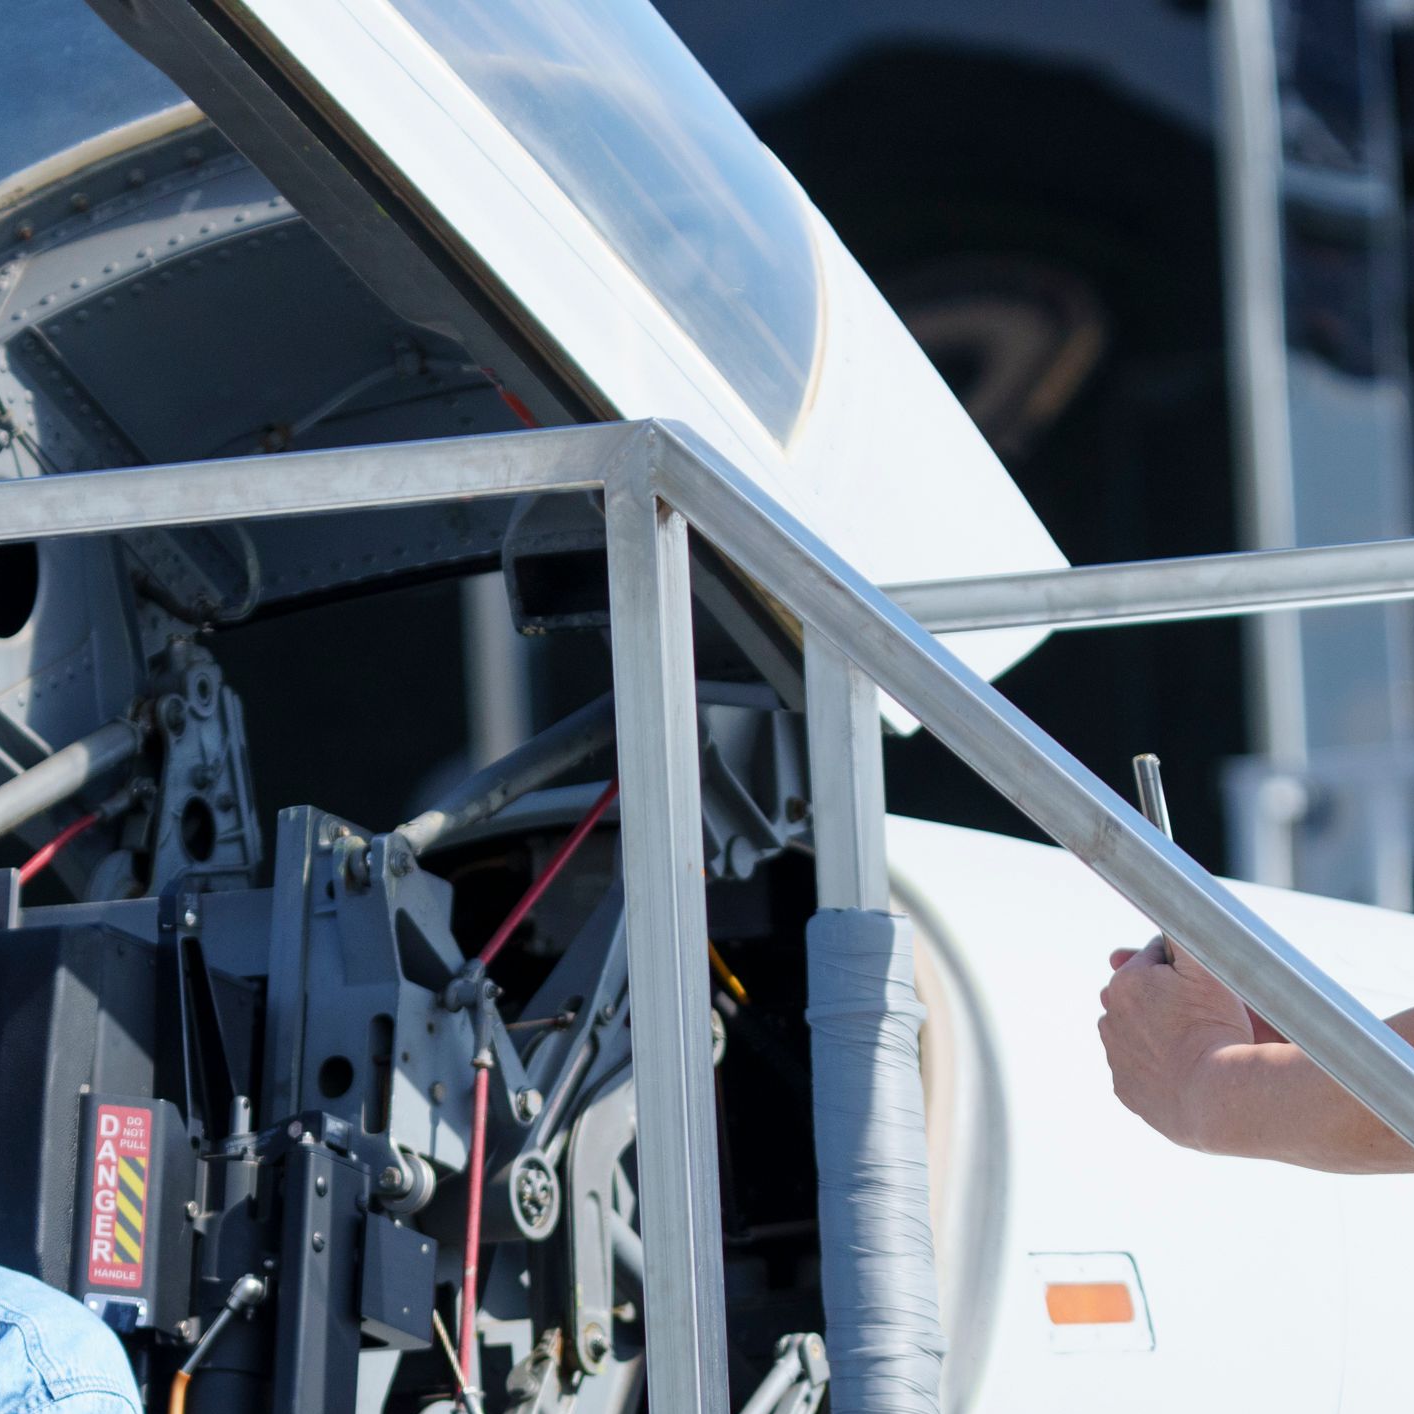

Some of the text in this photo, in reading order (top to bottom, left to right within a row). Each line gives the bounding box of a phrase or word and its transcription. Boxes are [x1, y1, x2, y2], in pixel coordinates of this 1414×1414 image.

[126, 1116, 143, 1126] DO
[123, 1127, 145, 1138] NOT
[119, 1138, 146, 1150] PULL
[92, 1114, 120, 1264] DANGER
[93, 1268, 137, 1281] HANDLE
